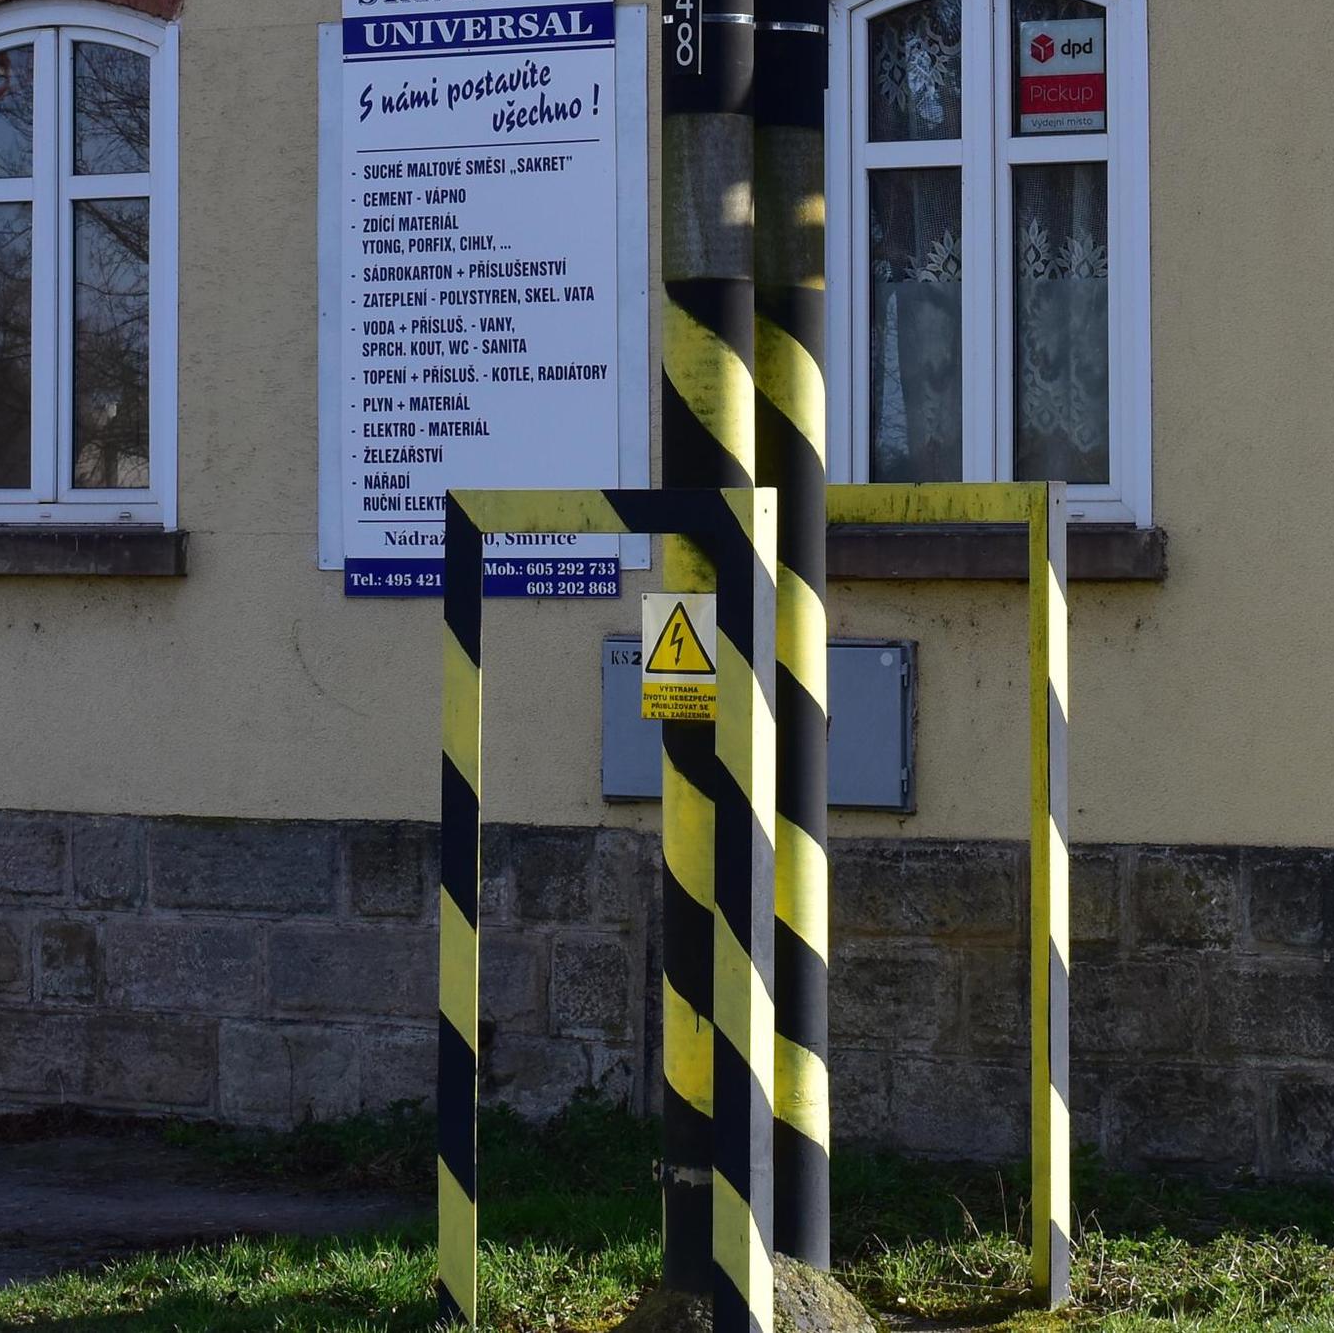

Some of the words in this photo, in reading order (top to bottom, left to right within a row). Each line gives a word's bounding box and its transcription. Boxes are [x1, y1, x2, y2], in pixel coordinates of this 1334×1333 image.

[363, 10, 593, 47] UNIVERSAL
[1061, 37, 1093, 59] dpd
[360, 83, 374, 122] S
[382, 77, 439, 115] námi
[447, 60, 551, 111] postavíte
[1030, 84, 1094, 104] Pickup
[363, 159, 403, 180] SUCHÉ
[407, 157, 462, 178] MALTOVÉ
[465, 156, 506, 176] SMĚSI
[363, 190, 413, 207] CEMENT
[425, 187, 466, 205] VÁPNO
[363, 214, 395, 233] ZDÍCÍ
[398, 212, 459, 232] MATERIÁL
[362, 239, 405, 255] YTONG,
[408, 237, 456, 254] PORFIX,
[460, 235, 497, 252] CIHLY,
[363, 264, 452, 283] SÁDROKARTON
[469, 257, 567, 278] PŘÍSLUŠENSTVÍ
[363, 289, 427, 308] ZATEPLENÍ
[439, 288, 521, 306] POLYSTYREN,
[525, 287, 560, 303] SKEL.
[564, 286, 595, 301] VATA
[363, 320, 395, 336] VODA
[411, 315, 467, 334] PŘÍSLUŠ.
[479, 317, 515, 334] VANY,
[362, 341, 407, 357] SPRCH.
[410, 340, 445, 357] KOUT,
[449, 340, 470, 355] WC
[481, 338, 527, 354] SANITA
[363, 367, 407, 385] TOPENÍ
[423, 364, 479, 383] PŘÍSLUŠ.
[492, 366, 534, 383] KOTLE,
[538, 362, 607, 381] RADIÁTORY
[363, 397, 393, 413] PLYN
[409, 392, 470, 411] MATERIÁL
[363, 422, 416, 438] ELEKTRO
[428, 418, 490, 437] MATERIÁL
[363, 445, 443, 464] ŽELEZÁŘSTVÍ
[363, 471, 410, 490] NÁŘADÍ
[363, 493, 401, 512] RUČNÍ
[526, 563, 554, 576] 605
[556, 563, 586, 576] 292
[588, 562, 616, 576] 733
[351, 573, 382, 587] Tel.:
[385, 573, 412, 587] 495
[415, 573, 442, 587] 421
[526, 582, 554, 596] 603
[557, 582, 585, 596] 202
[588, 582, 617, 596] 868
[659, 683, 699, 693] VÝSTRAHA
